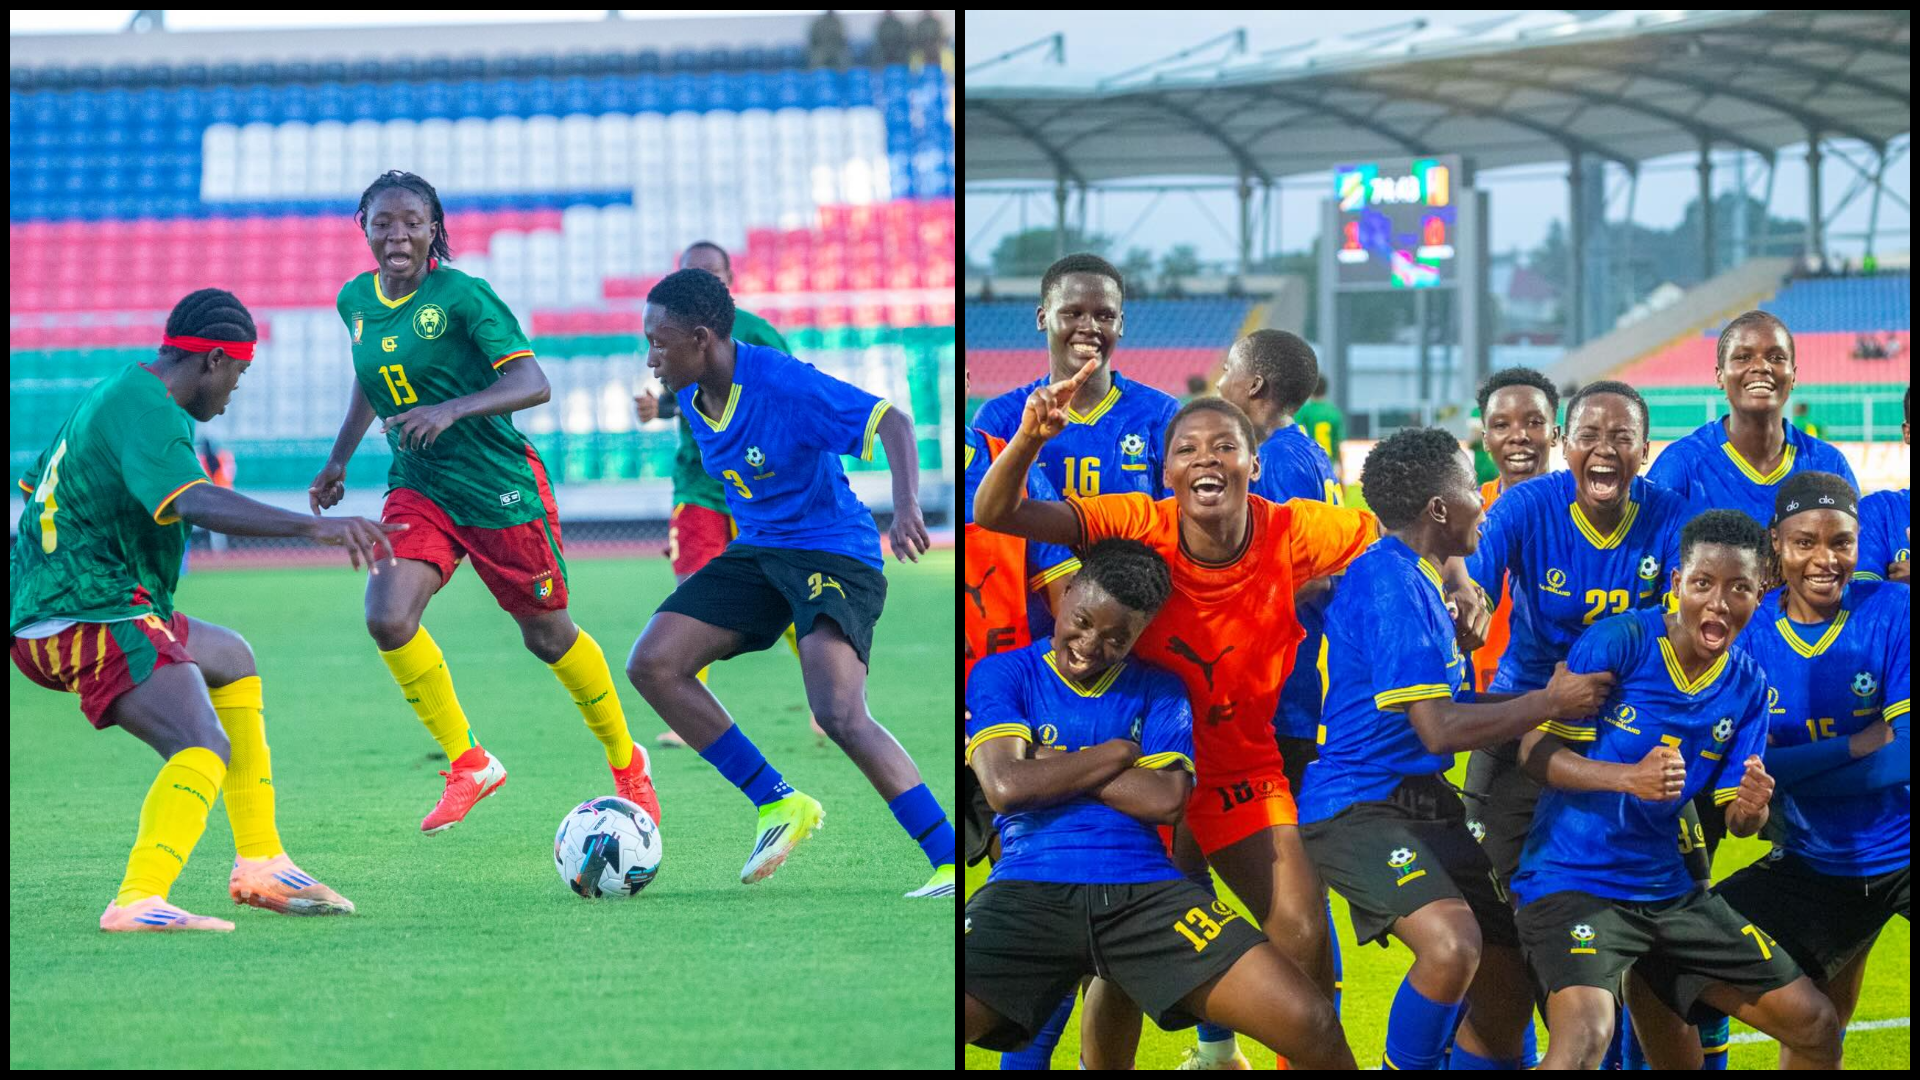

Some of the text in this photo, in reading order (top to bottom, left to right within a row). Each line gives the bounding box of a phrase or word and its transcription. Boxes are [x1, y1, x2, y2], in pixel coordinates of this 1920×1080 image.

[378, 364, 418, 406] 13
[722, 469, 753, 499] 3
[1062, 456, 1100, 497] 16
[1818, 495, 1835, 504] alo
[807, 572, 822, 600] 3
[1582, 588, 1629, 625] 23
[1173, 907, 1222, 953] 13
[1741, 924, 1772, 960] 7
